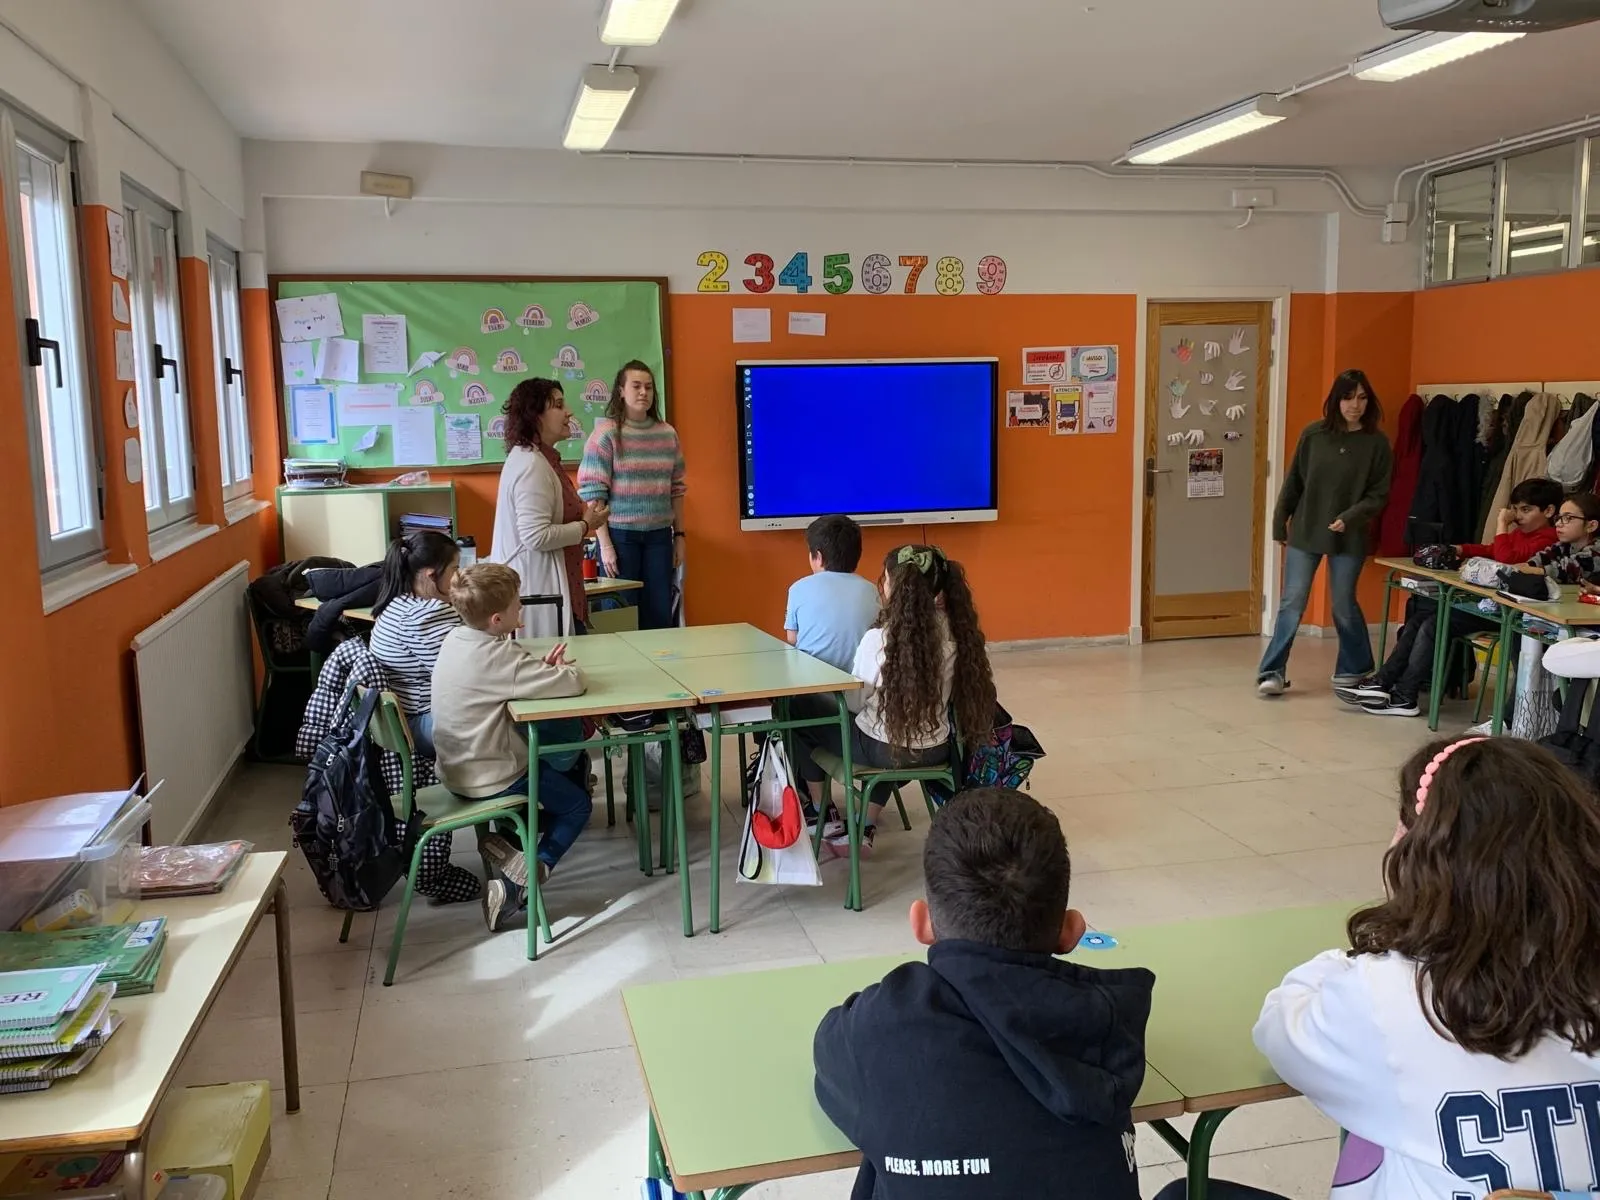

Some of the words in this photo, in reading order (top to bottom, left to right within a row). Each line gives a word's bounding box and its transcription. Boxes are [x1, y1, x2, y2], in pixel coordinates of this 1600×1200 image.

[697, 251, 729, 292] 2
[743, 253, 775, 293] 3
[779, 252, 812, 293] 4
[823, 253, 853, 294] 5
[861, 254, 891, 294] 6
[899, 256, 928, 293] 7
[935, 256, 964, 296] 8
[977, 255, 1007, 295] 9
[885, 1156, 920, 1176] PLEASE,
[922, 1159, 960, 1176] MORE
[963, 1158, 990, 1175] FUN
